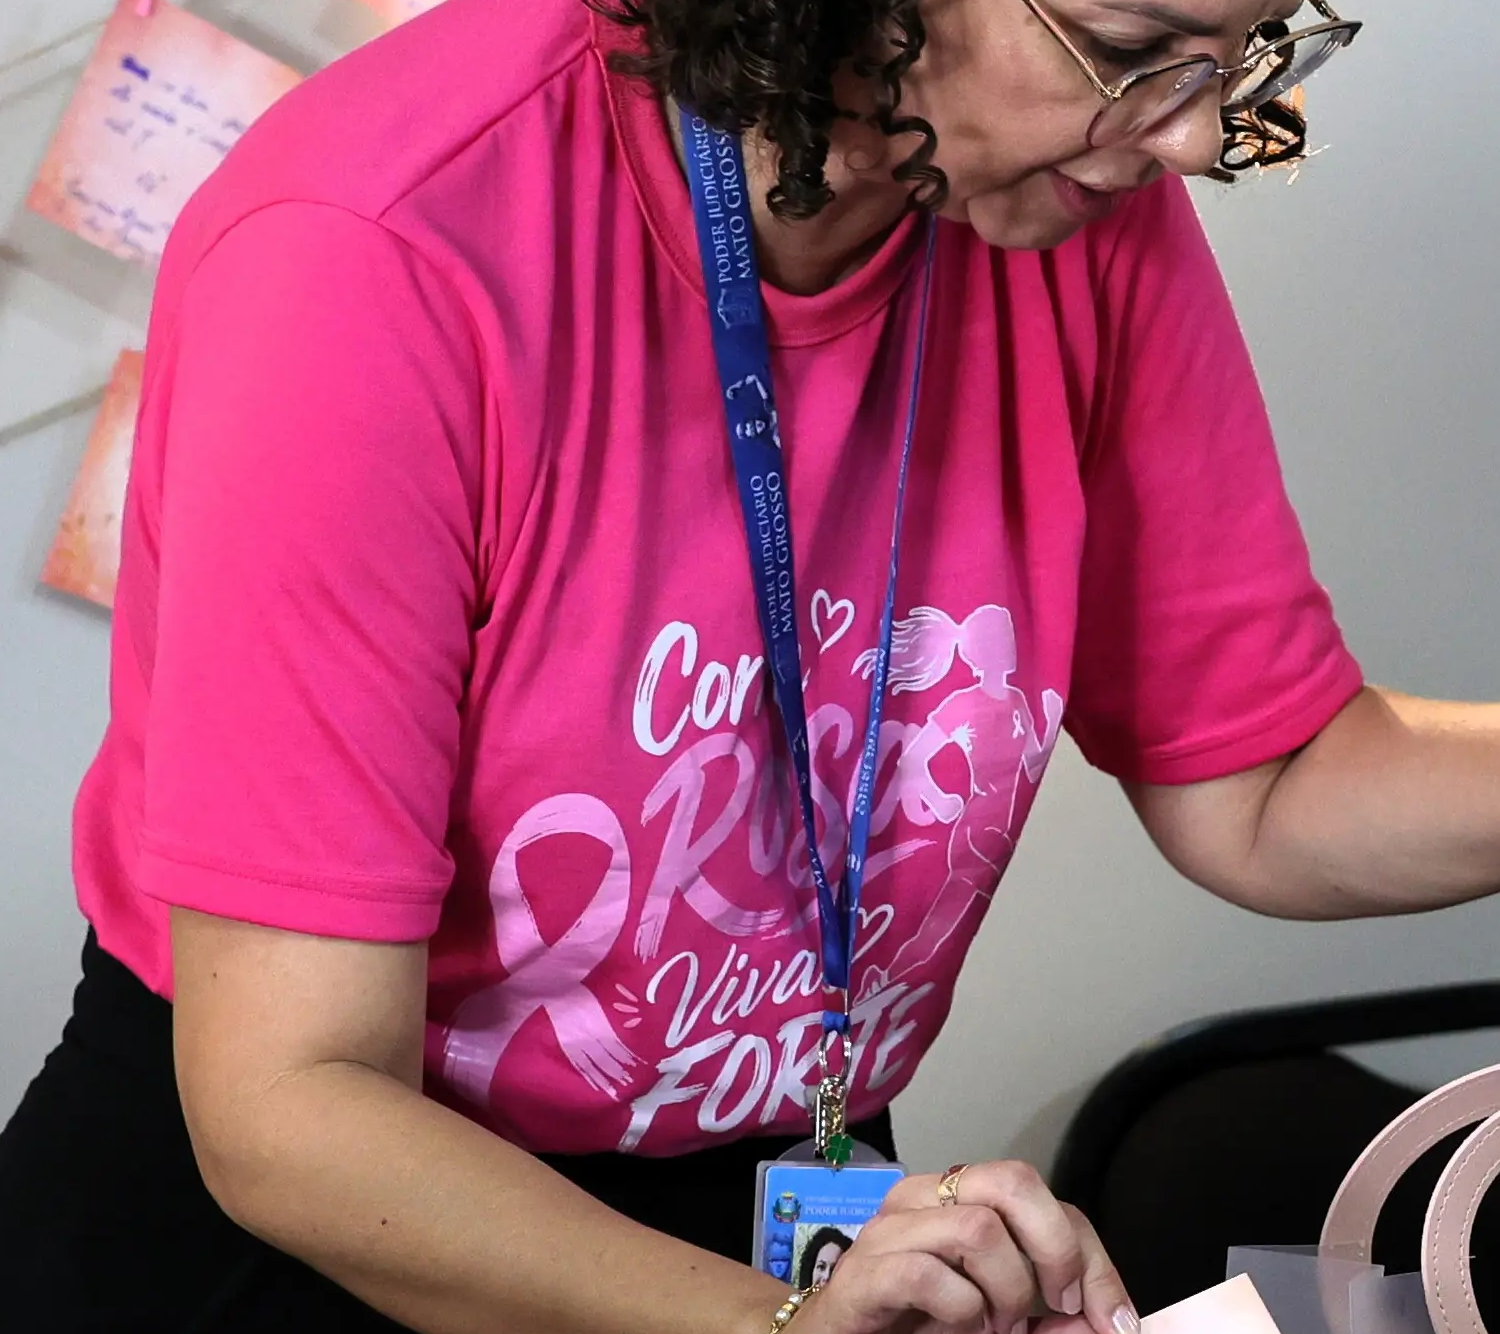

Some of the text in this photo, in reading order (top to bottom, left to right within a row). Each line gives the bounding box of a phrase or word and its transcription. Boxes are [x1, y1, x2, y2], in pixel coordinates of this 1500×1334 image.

[711, 222, 733, 284] PODER
[729, 215, 753, 280] MATO
[750, 474, 777, 576] JUDICIÁRIO
[766, 471, 793, 633] MATO GROSSO
[618, 981, 936, 1154] FORTE
